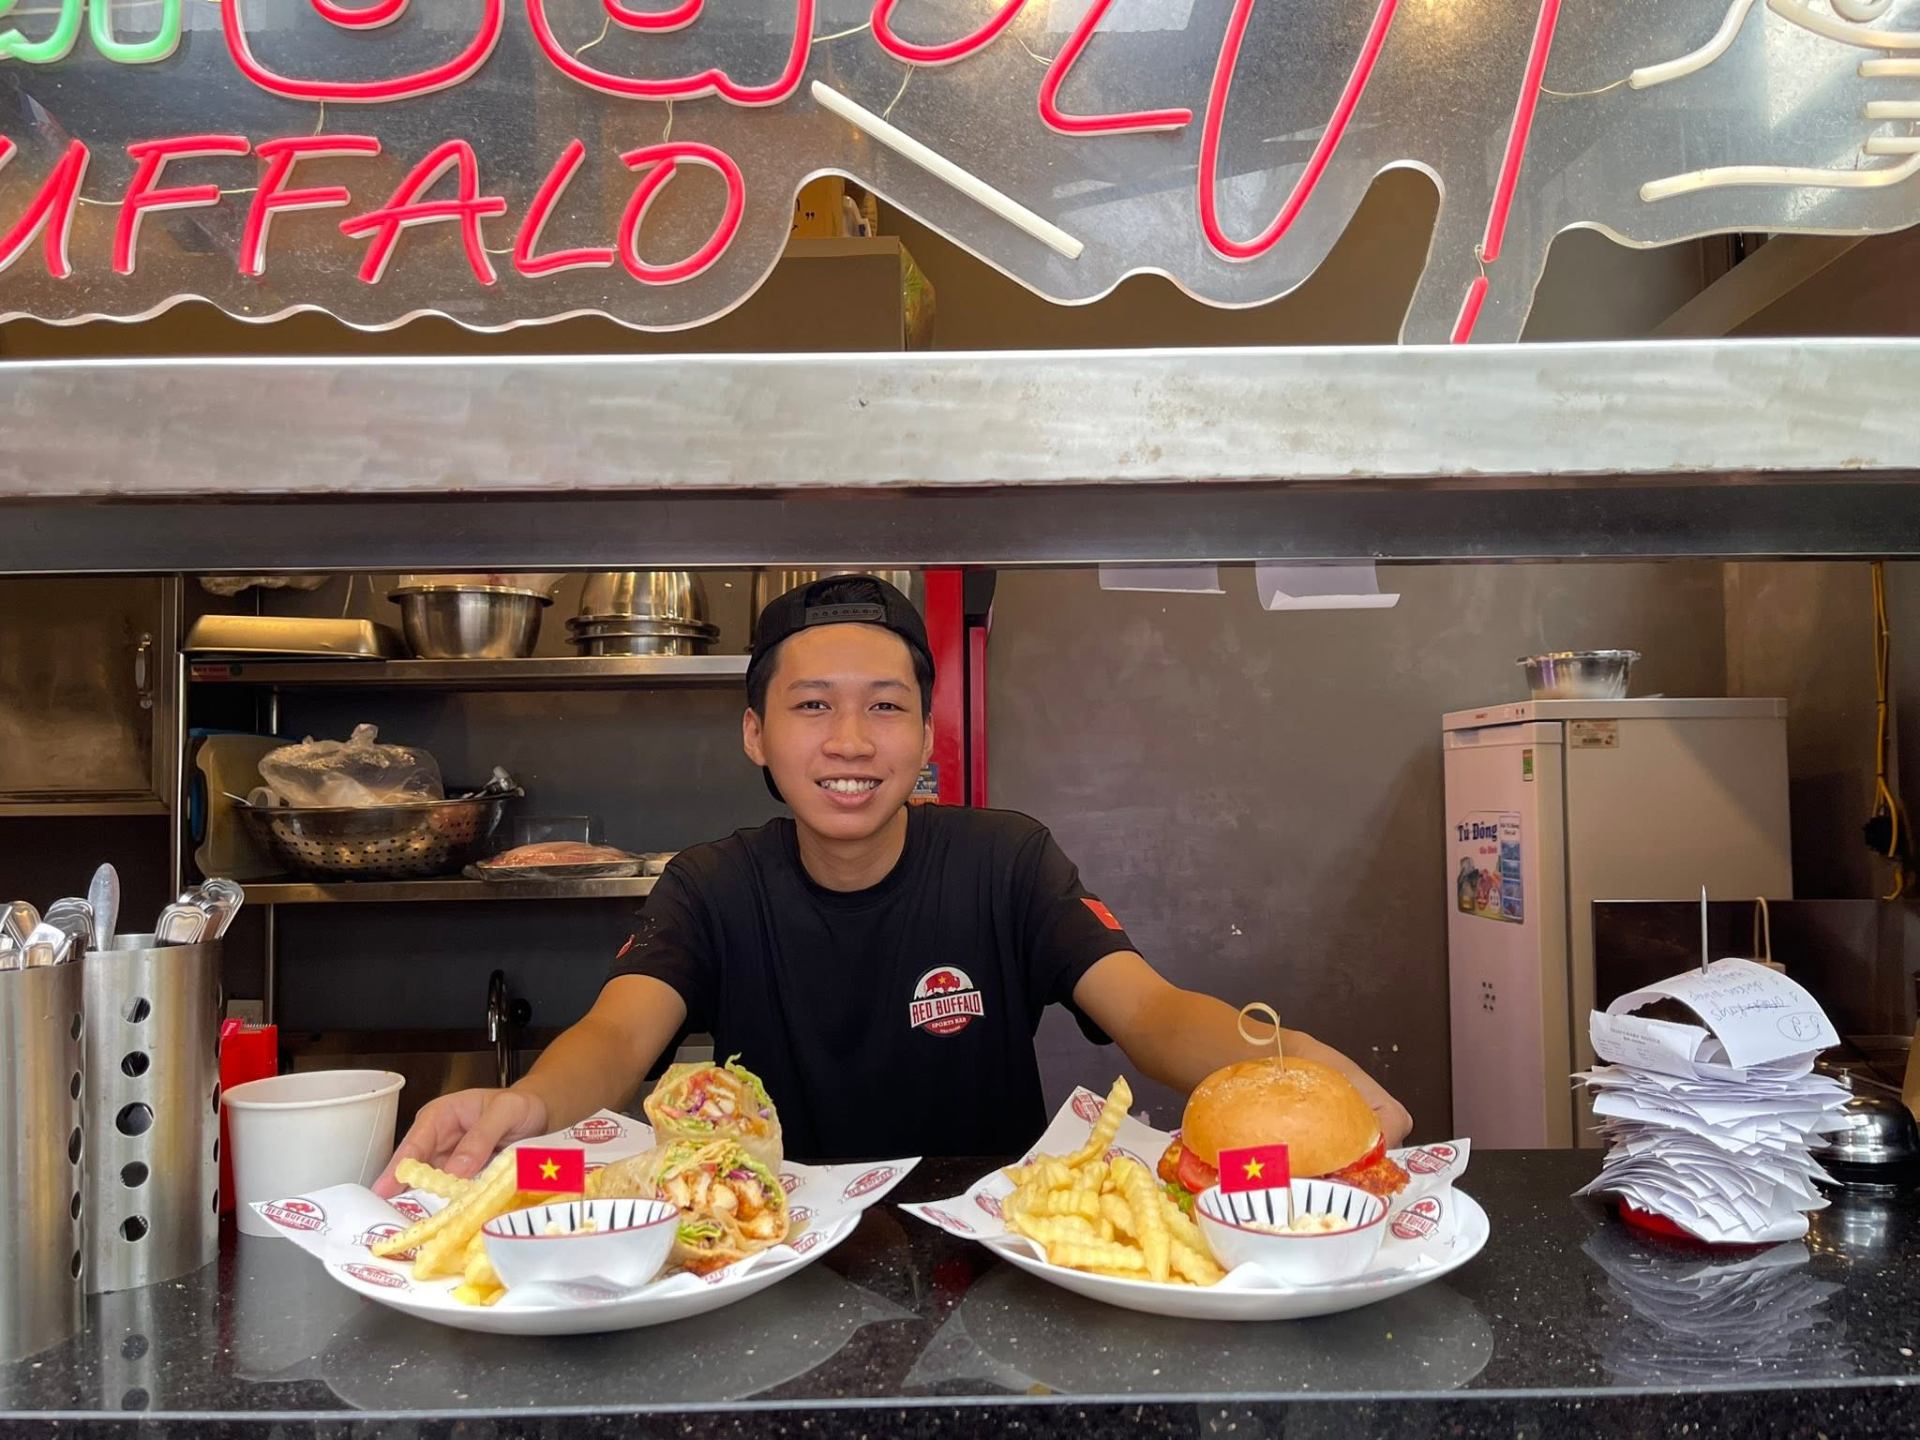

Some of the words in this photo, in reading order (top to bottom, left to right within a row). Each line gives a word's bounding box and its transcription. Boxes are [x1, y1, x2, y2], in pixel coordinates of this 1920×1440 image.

[912, 1001, 933, 1025] RED
[936, 994, 982, 1017] BUFFALO
[265, 1205, 284, 1217] RED
[285, 1211, 322, 1230] BUFFALO
